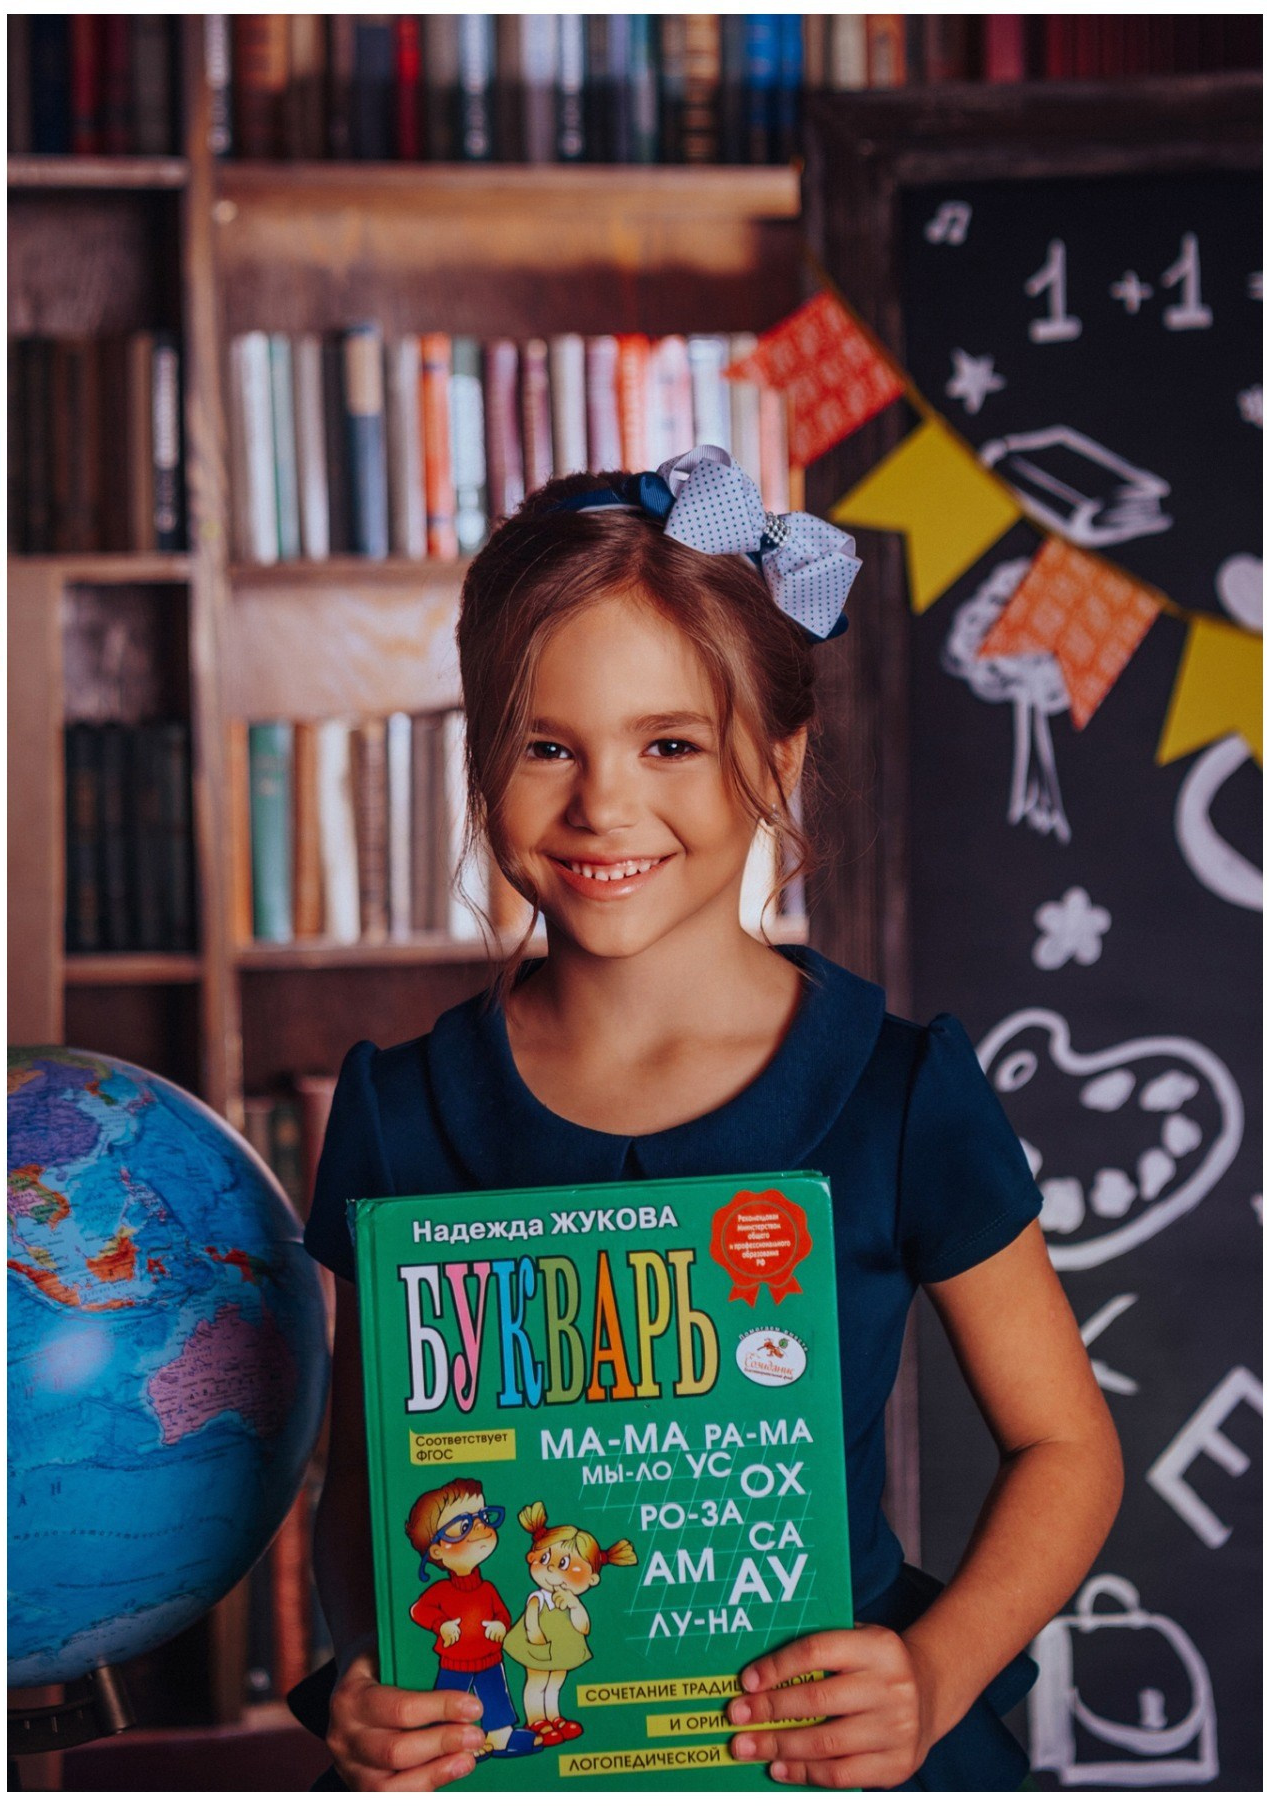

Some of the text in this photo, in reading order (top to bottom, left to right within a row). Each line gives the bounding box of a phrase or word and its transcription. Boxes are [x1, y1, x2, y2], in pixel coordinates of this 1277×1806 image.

[412, 1205, 679, 1245] Надежда ЖУКОВА
[397, 1250, 719, 1414] БУКВАРЬ
[415, 1431, 509, 1448] Соответствует
[415, 1447, 454, 1462] ФГОС
[540, 1417, 815, 1461] МА-МА РА-МА
[582, 1451, 807, 1498] МЫ-ЛО УС ОХ
[640, 1499, 744, 1532] РО-ЗА
[748, 1521, 805, 1552] СА
[642, 1547, 810, 1606] АМ АУ
[648, 1607, 754, 1639] ЛУ-НА
[585, 1684, 678, 1703] СОЧЕТАНИЕ
[669, 1717, 682, 1732] И
[569, 1746, 721, 1773] ЛОГОПЕДИЧЕСКОЙ
